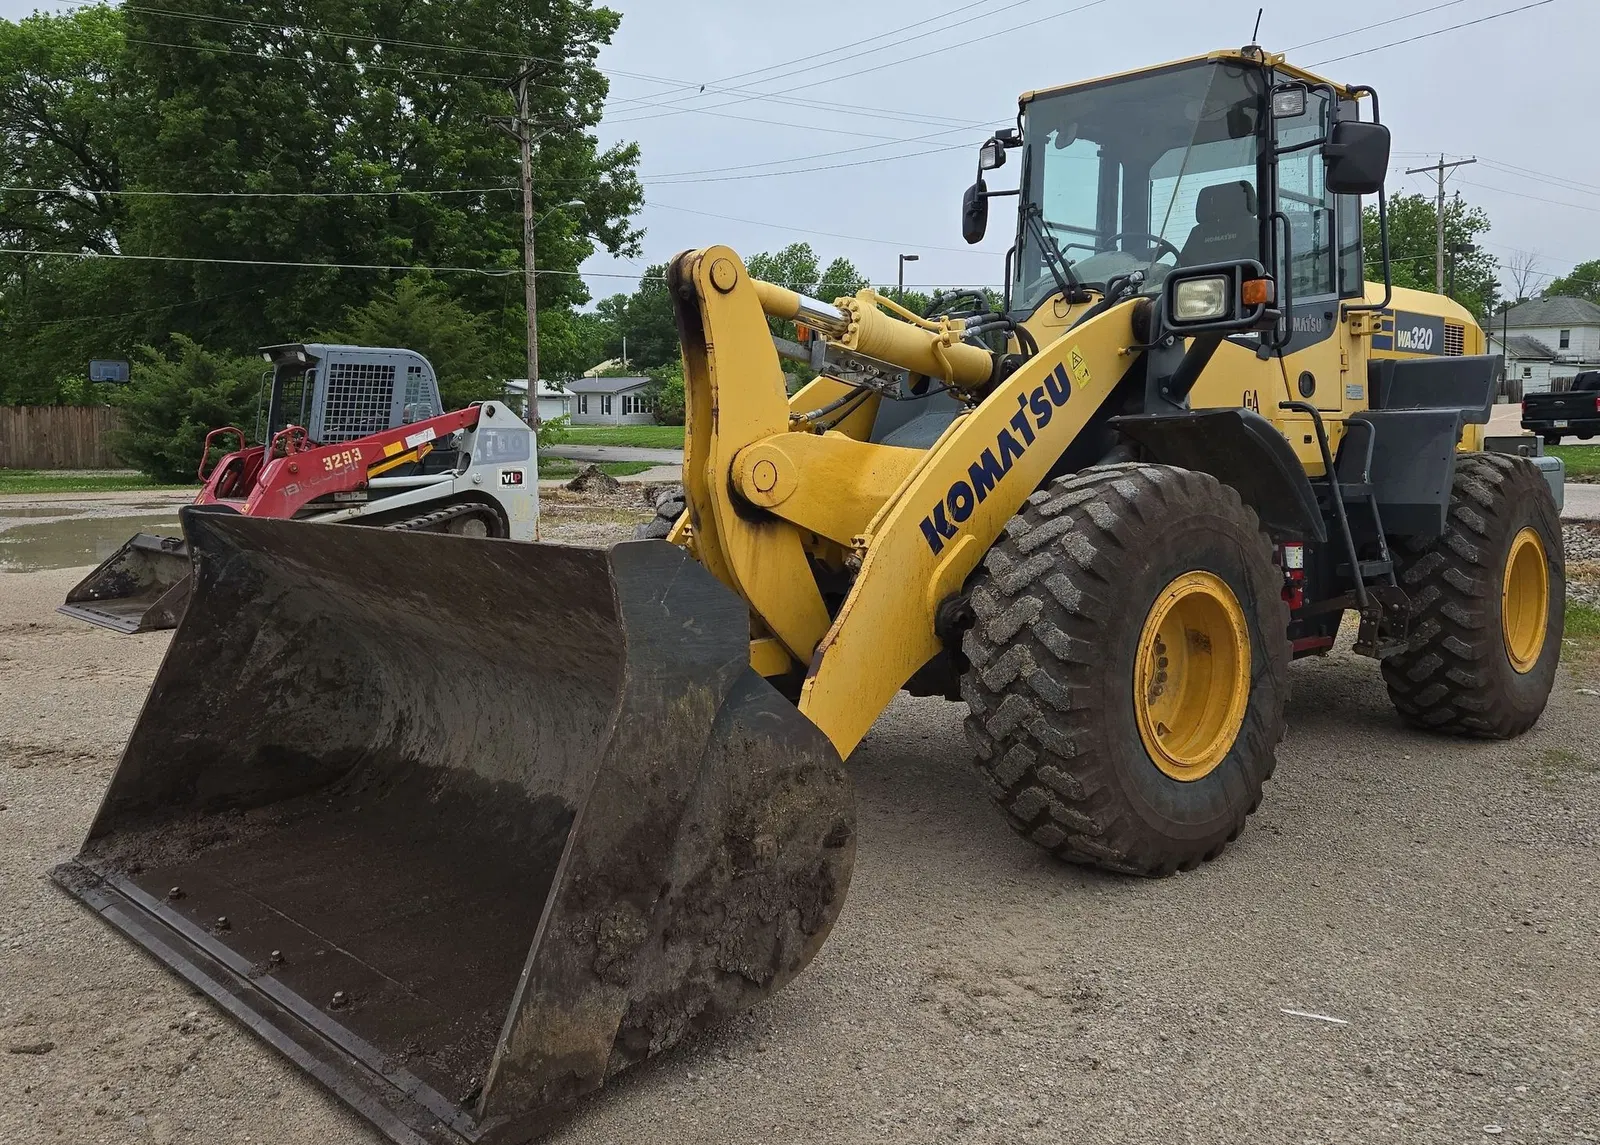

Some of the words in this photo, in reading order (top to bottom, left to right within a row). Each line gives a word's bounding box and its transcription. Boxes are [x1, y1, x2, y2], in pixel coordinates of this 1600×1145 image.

[1279, 314, 1322, 333] KMATSU
[1397, 326, 1433, 351] WA320
[322, 447, 363, 472] 3293
[919, 362, 1072, 556] KOMATSU
